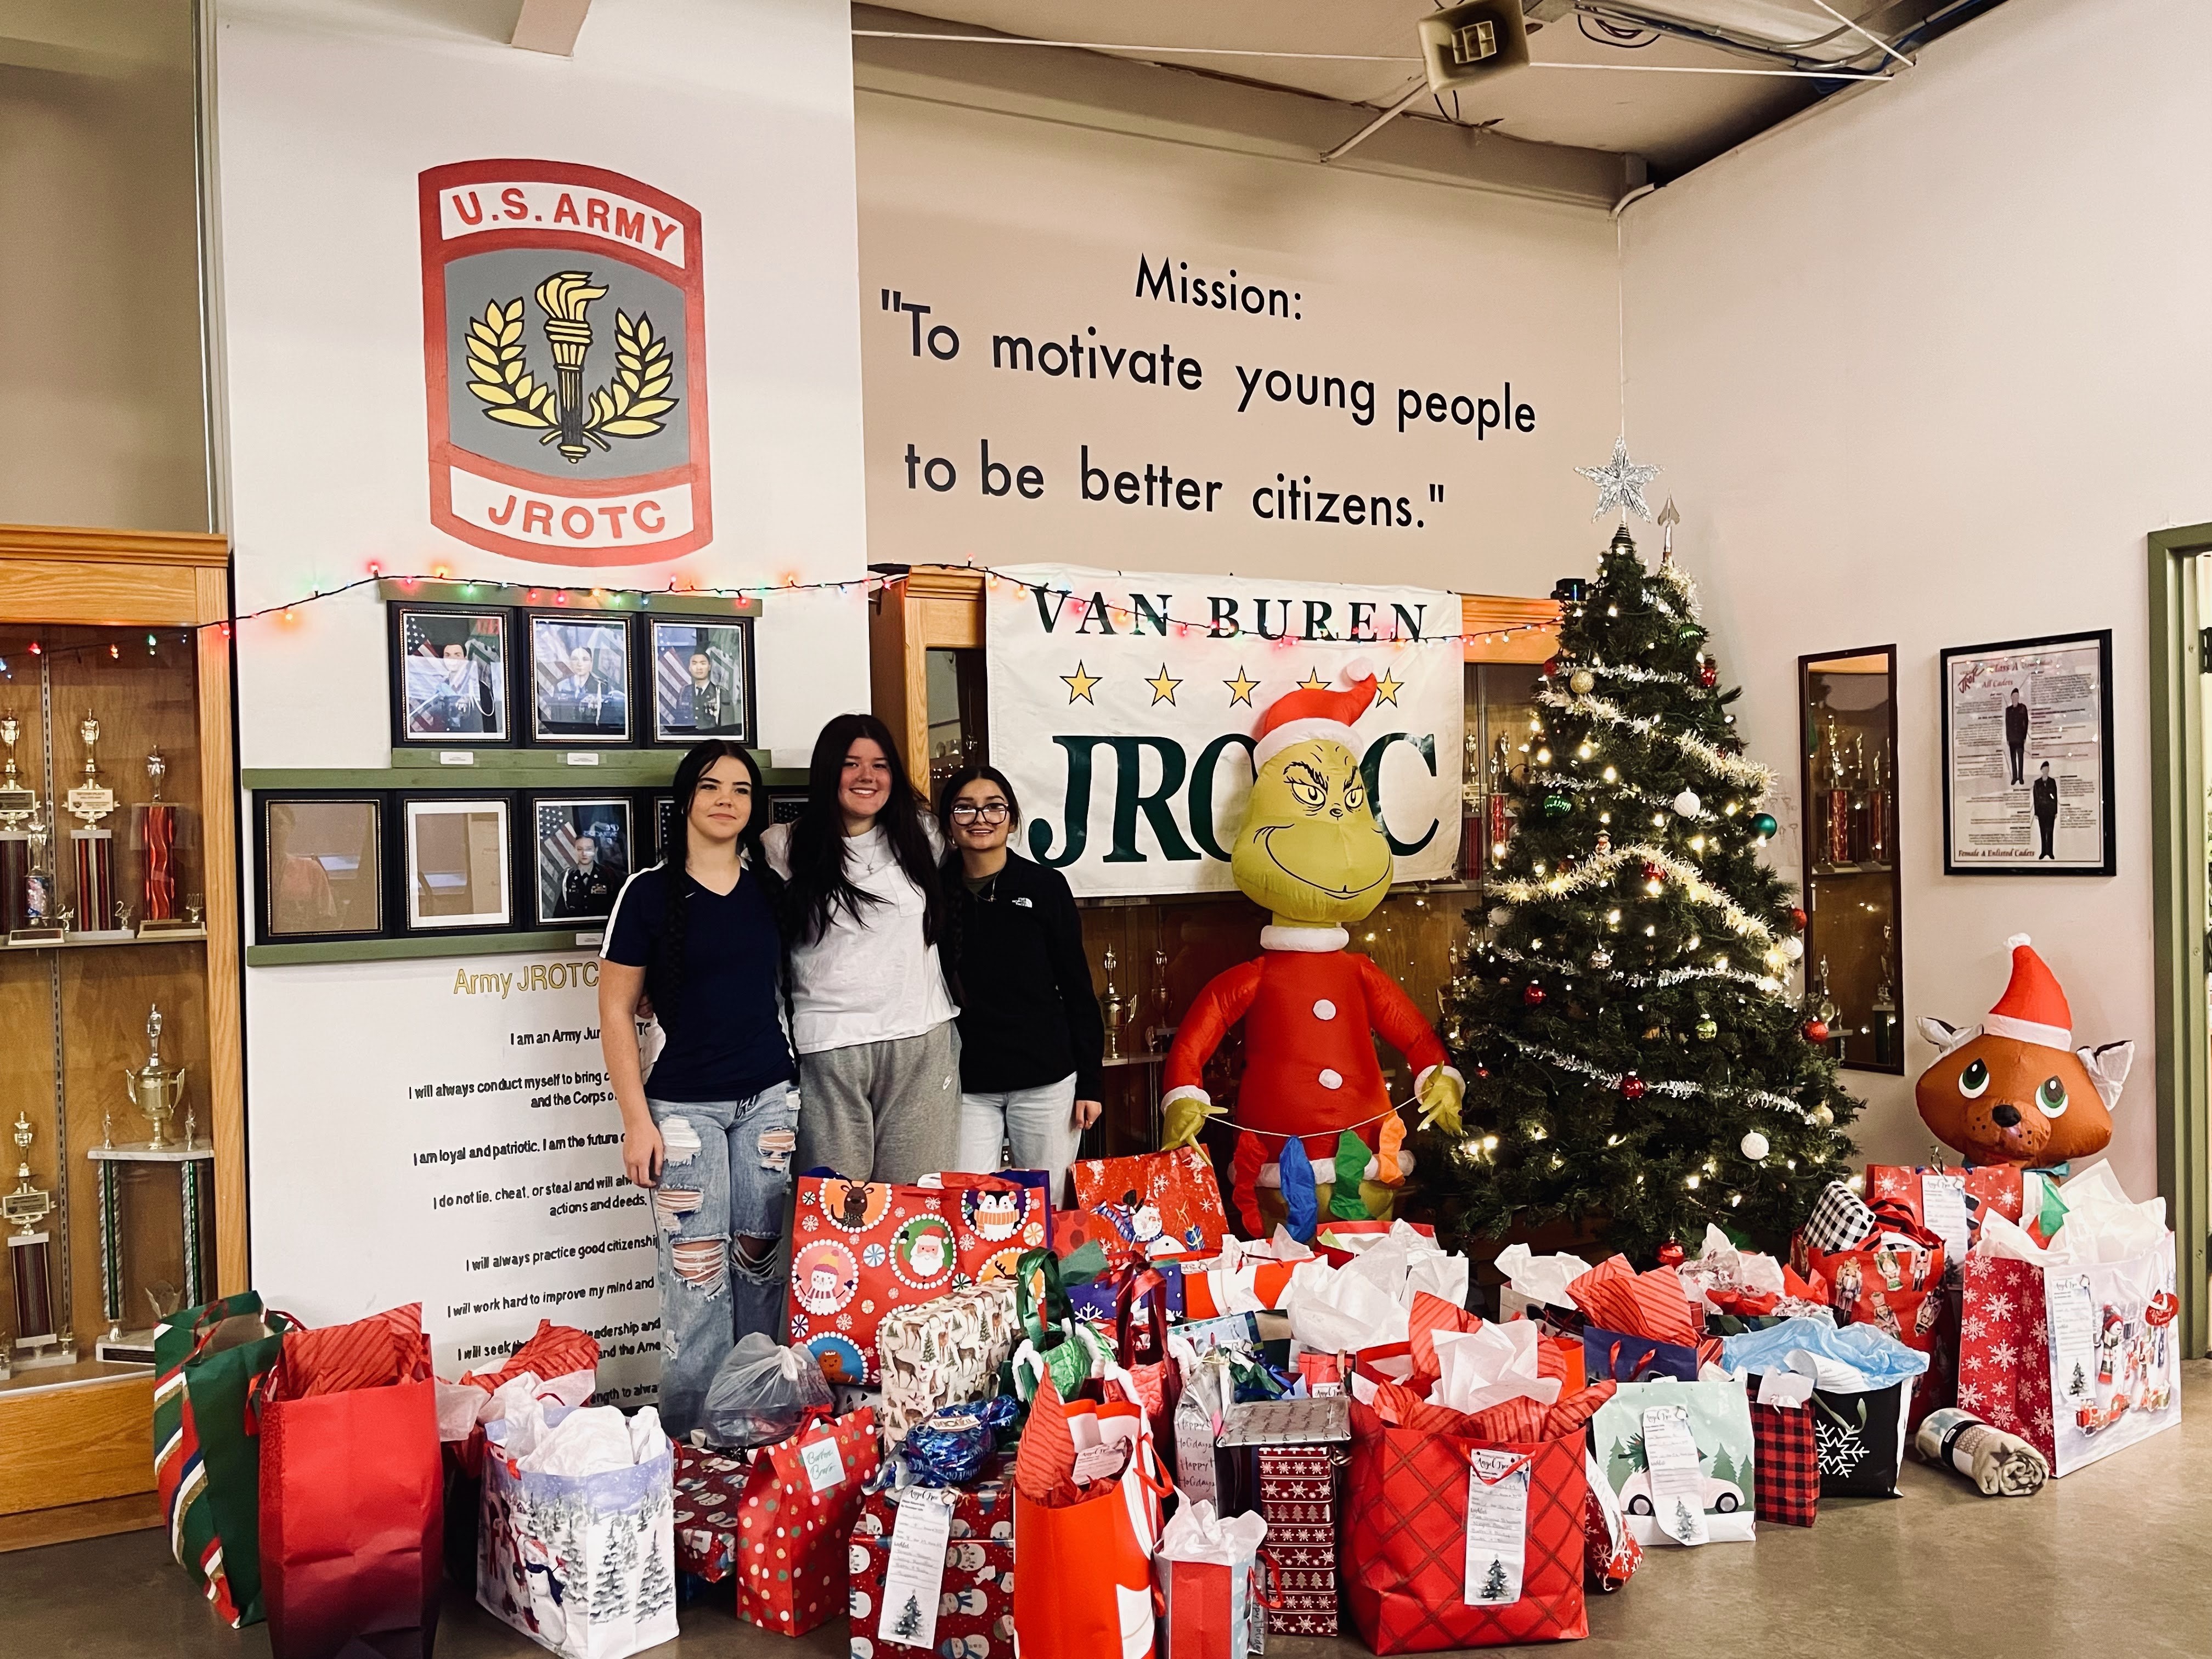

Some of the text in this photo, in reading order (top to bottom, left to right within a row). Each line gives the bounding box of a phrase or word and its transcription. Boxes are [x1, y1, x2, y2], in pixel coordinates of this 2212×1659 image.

[452, 188, 678, 252] U.S. ARMY
[1135, 252, 1303, 320] Mission:
[881, 289, 1536, 441] "To motivate young people
[905, 439, 1445, 528] to be better citizens."
[489, 495, 665, 539] JROTC
[1030, 589, 1427, 643] VAN BUREN
[1028, 733, 1439, 868] JROC
[2015, 848, 2034, 856] Cadets
[57, 904, 75, 919] 2nd
[115, 901, 134, 917] 2nd
[453, 962, 599, 999] Army JROTC
[511, 1034, 514, 1045] I
[517, 1034, 534, 1045] am
[537, 1034, 550, 1043] an
[552, 1030, 582, 1044] Army
[409, 1087, 411, 1099] I
[415, 1085, 432, 1099] will
[436, 1084, 474, 1097] always
[478, 1078, 522, 1093] conduct
[525, 1074, 560, 1090] myself
[562, 1074, 572, 1084] to
[575, 1071, 601, 1086] bring
[531, 1095, 551, 1108] and
[554, 1093, 571, 1105] the
[573, 1091, 606, 1105] Corps
[414, 1153, 417, 1166] I
[420, 1153, 437, 1163] am
[439, 1147, 465, 1163] loyal
[470, 1145, 491, 1158] and
[493, 1140, 540, 1160] patriotic.
[543, 1139, 546, 1150] I
[549, 1139, 566, 1150] am
[567, 1136, 585, 1148] the
[587, 1134, 618, 1146] future
[434, 1198, 436, 1209] I
[439, 1195, 454, 1207] do
[456, 1192, 474, 1204] not
[532, 1187, 544, 1196] or
[546, 1181, 572, 1195] steal
[574, 1178, 594, 1191] and
[596, 1176, 613, 1188] will
[550, 1193, 647, 1216] actions and deeds.
[467, 1260, 469, 1271] I
[472, 1257, 489, 1271] will
[493, 1254, 529, 1267] always
[533, 1246, 575, 1265] practice
[578, 1242, 605, 1259] good
[448, 1276, 654, 1318] I will work hard to improve my mind and
[458, 1348, 461, 1361] I
[465, 1346, 481, 1359] will
[484, 1341, 510, 1356] seek
[641, 1317, 661, 1331] and
[619, 1344, 635, 1356] the
[622, 1388, 631, 1398] to
[1176, 1437, 1213, 1453] Holidays
[1180, 1457, 1208, 1471] Happy
[1475, 1458, 1496, 1470] Angel
[1178, 1476, 1215, 1492] Holidays
